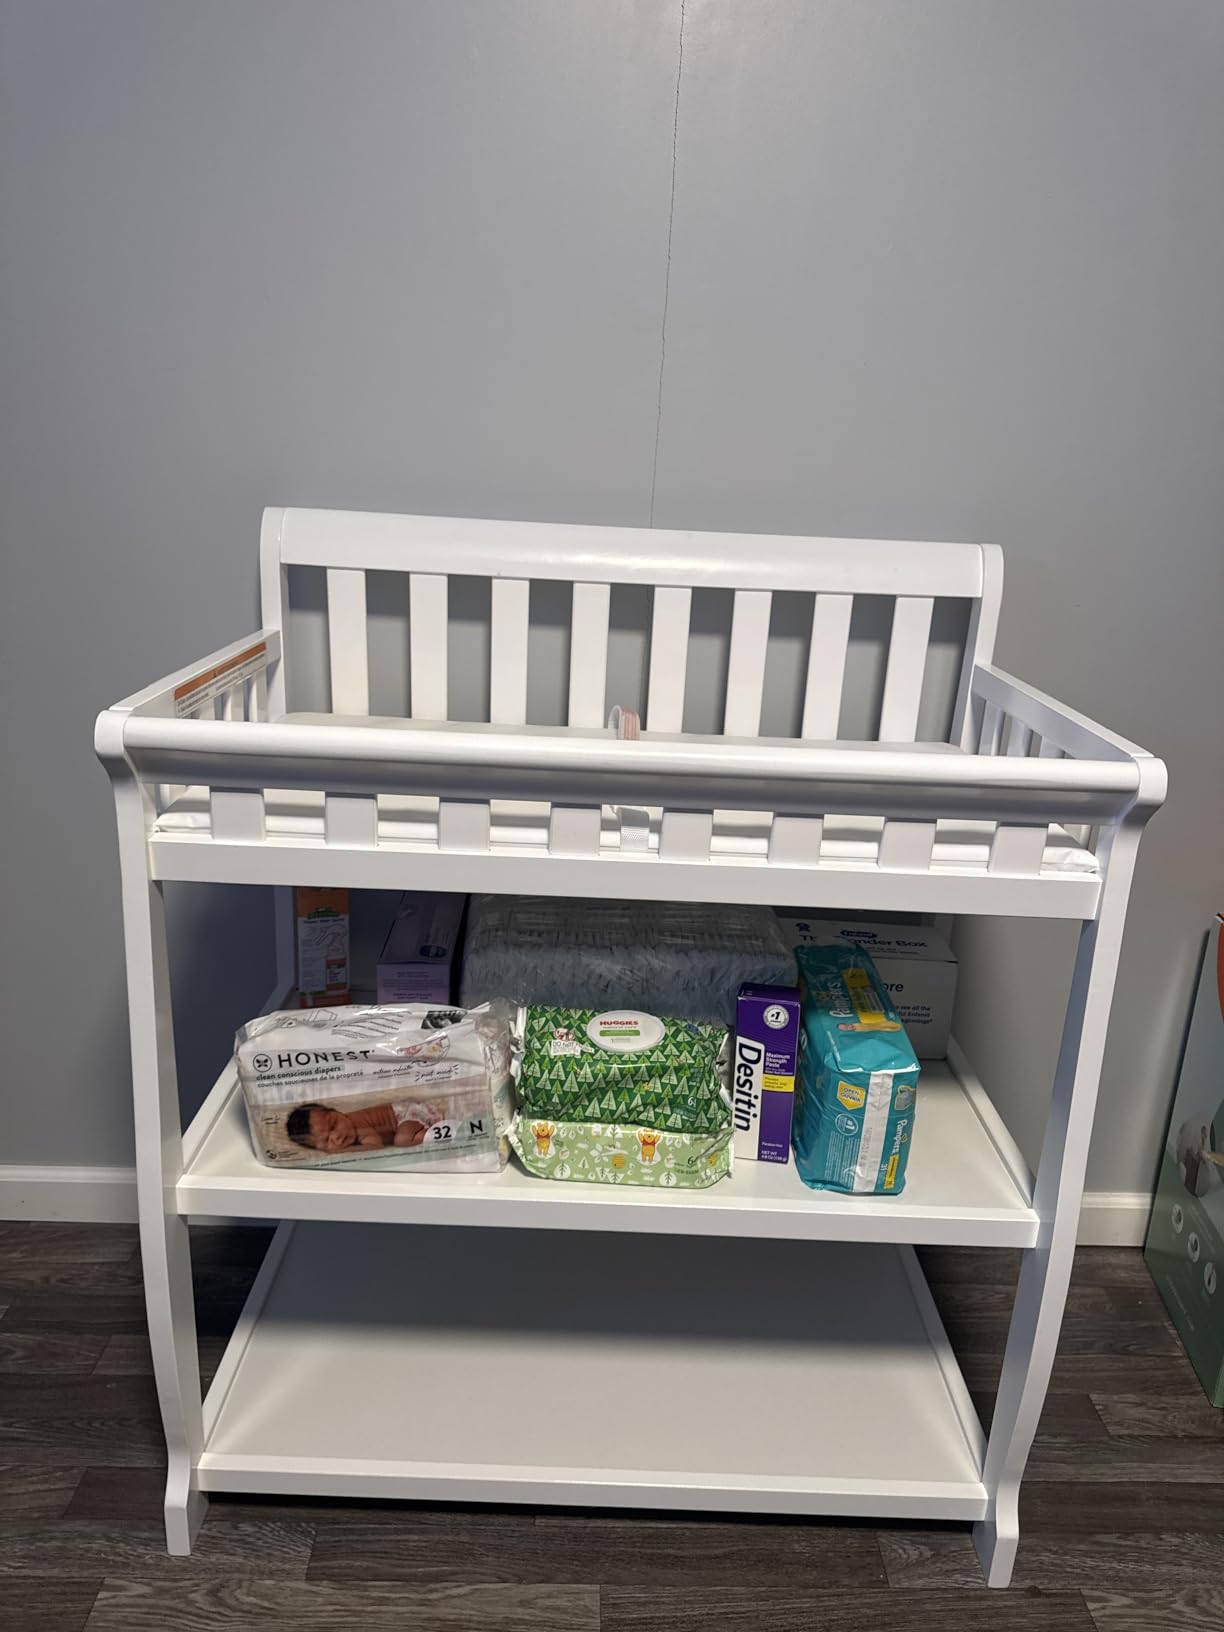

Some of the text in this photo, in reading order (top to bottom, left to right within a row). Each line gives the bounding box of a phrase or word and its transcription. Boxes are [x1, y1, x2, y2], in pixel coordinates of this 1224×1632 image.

[883, 983, 904, 992] ore
[828, 981, 853, 1018] Pampers
[277, 1050, 371, 1068] HONEST
[277, 1070, 313, 1079] conscious
[314, 1066, 342, 1076] diapers
[735, 1042, 762, 1131] Desitin
[843, 1087, 859, 1095] OPEN
[433, 1125, 452, 1140] 32
[469, 1119, 484, 1134] N
[892, 1118, 908, 1154] Pampers
